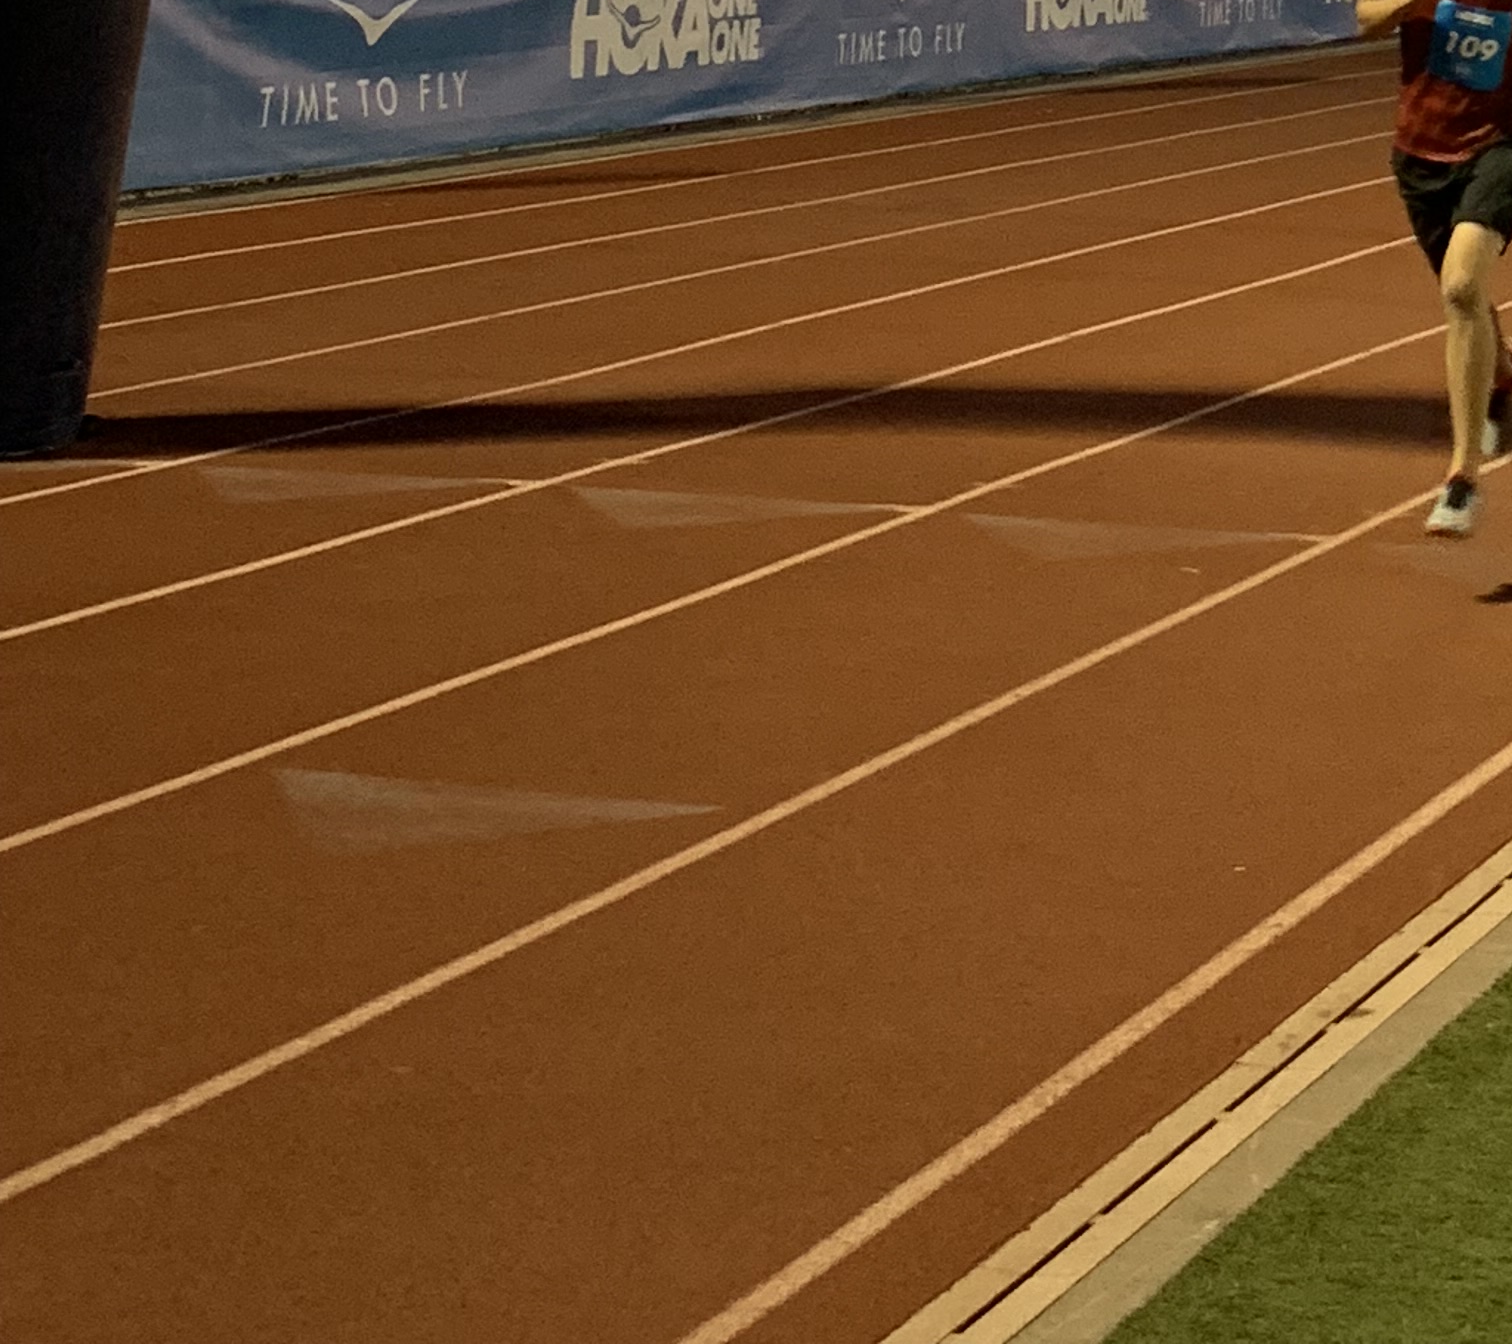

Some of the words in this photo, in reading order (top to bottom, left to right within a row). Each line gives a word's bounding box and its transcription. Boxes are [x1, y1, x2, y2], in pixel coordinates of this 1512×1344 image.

[711, 17, 762, 65] ONE
[837, 29, 886, 65] TIME
[897, 26, 922, 58] TO
[934, 21, 966, 54] FLY
[1446, 30, 1500, 62] 109
[259, 81, 339, 128] TIME
[356, 76, 398, 118] TO
[419, 69, 468, 112] FLY
